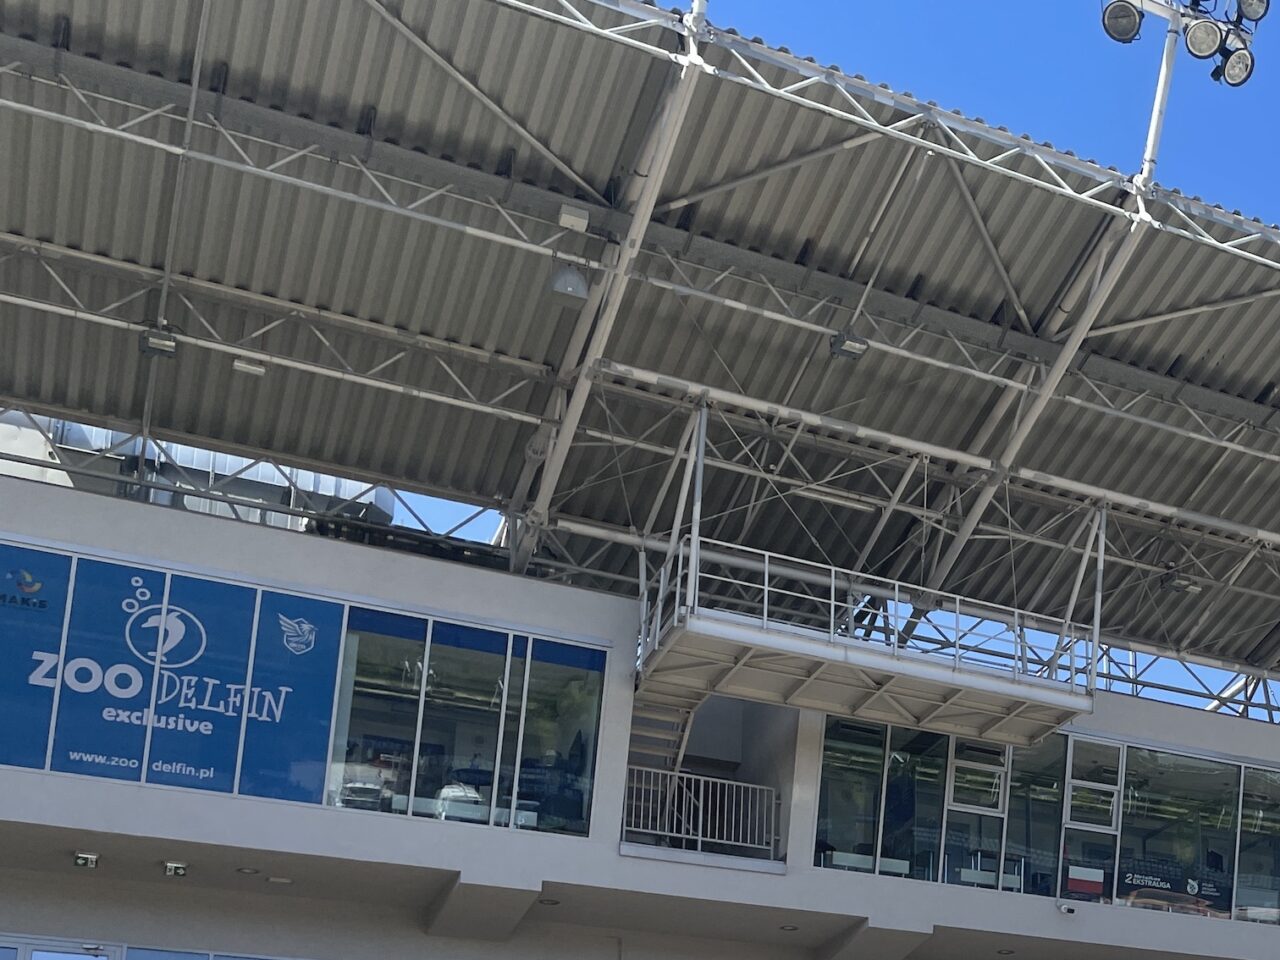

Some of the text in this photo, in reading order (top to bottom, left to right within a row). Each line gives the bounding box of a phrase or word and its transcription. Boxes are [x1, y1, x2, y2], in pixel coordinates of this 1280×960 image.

[28, 651, 293, 723] ZOO DELFIN
[102, 707, 213, 735] exclusive
